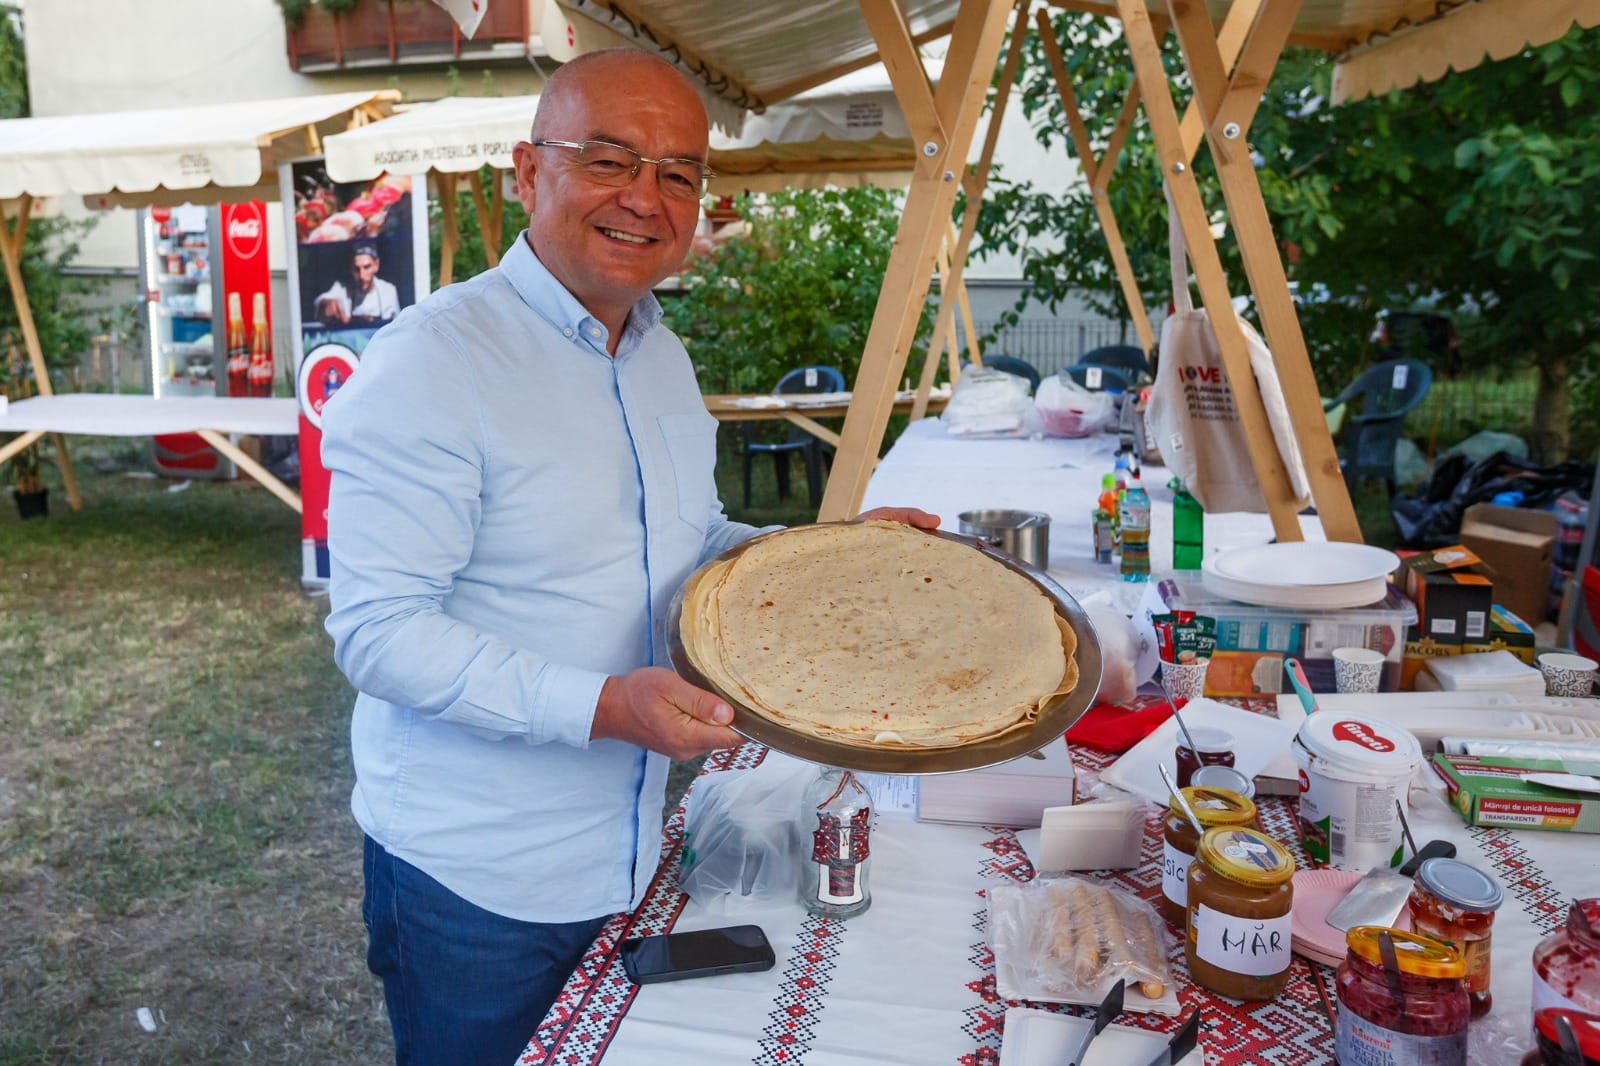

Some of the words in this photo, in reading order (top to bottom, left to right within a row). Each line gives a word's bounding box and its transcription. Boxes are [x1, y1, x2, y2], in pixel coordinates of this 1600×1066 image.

[1404, 645, 1451, 657] JACOBS
[1341, 723, 1390, 751] fineti
[1484, 813, 1537, 823] TRANSPARENTE
[1222, 923, 1283, 957] MĂR
